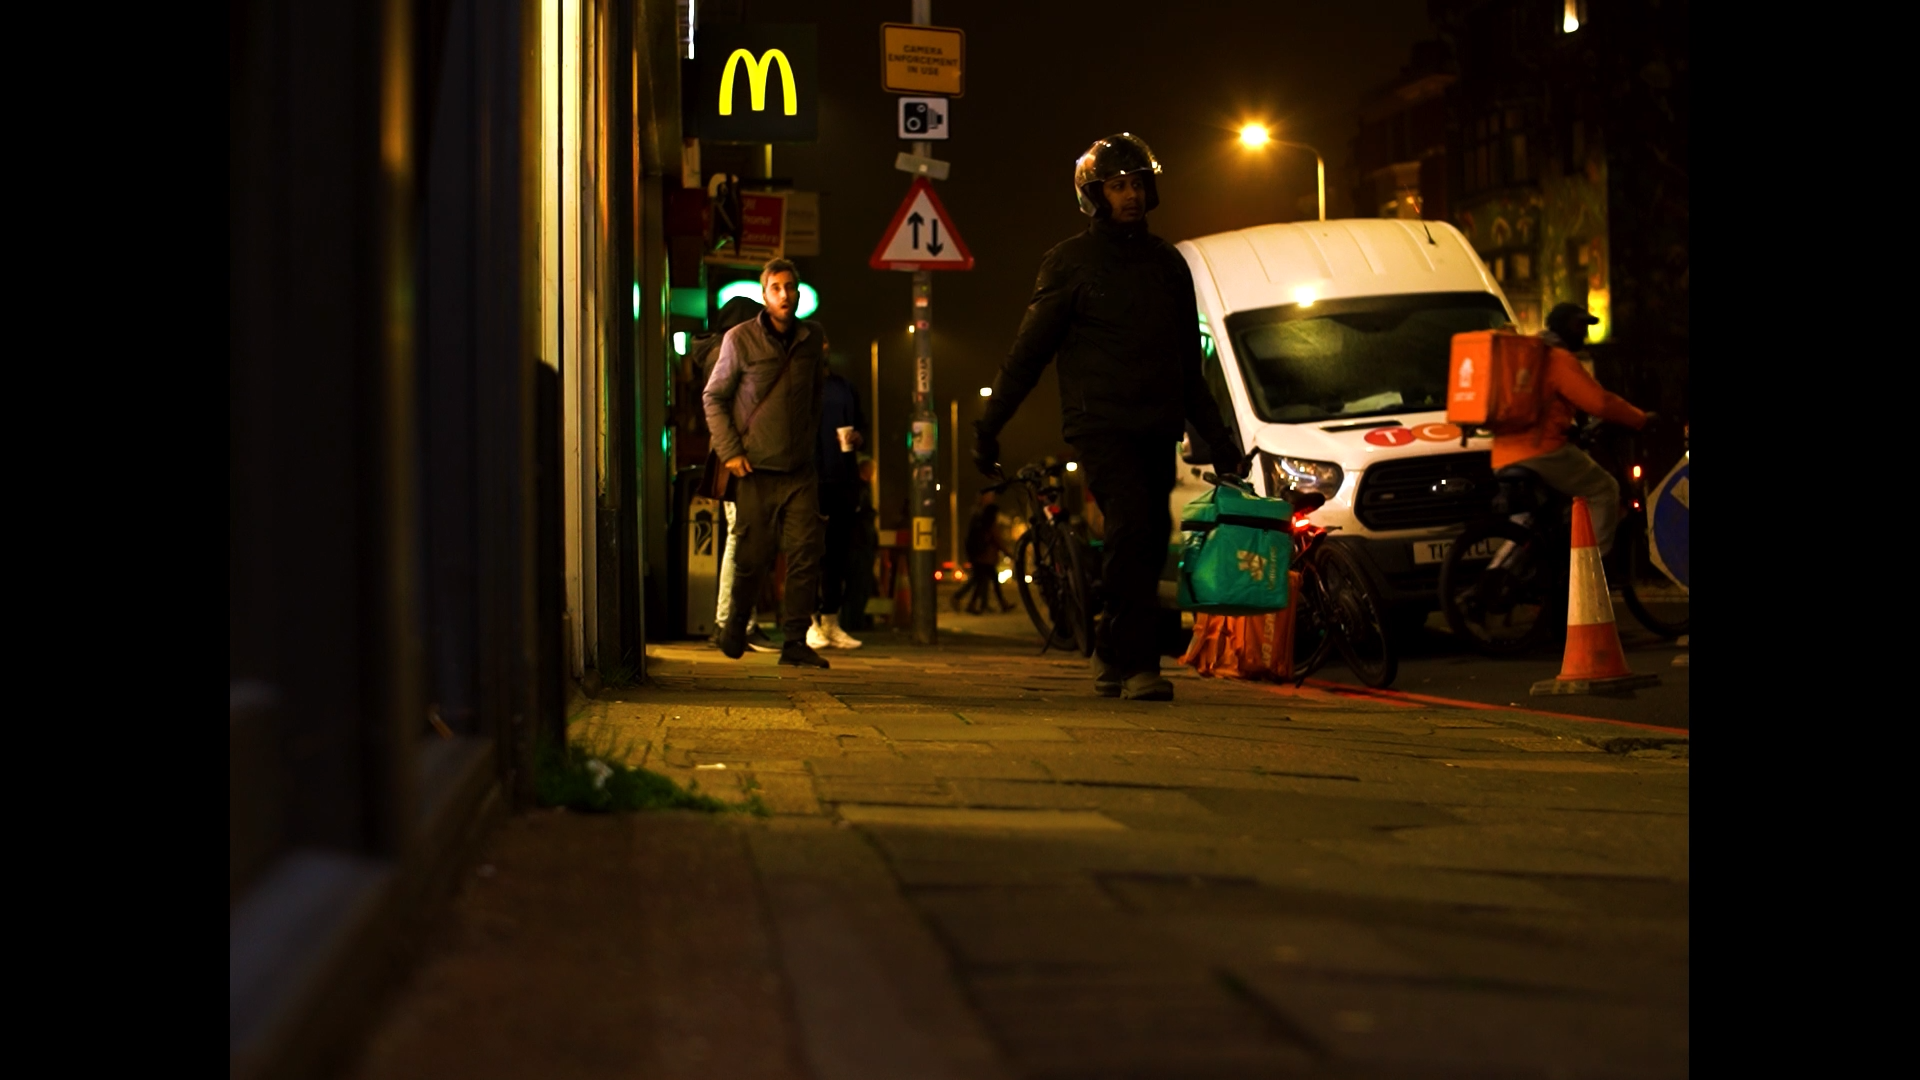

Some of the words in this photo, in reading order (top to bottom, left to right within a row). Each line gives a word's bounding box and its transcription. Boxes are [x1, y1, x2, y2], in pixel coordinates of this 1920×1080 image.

[903, 45, 944, 55] CAMERA
[887, 53, 959, 67] ENFORCEMENT
[907, 65, 919, 74] IN
[920, 66, 940, 77] USE
